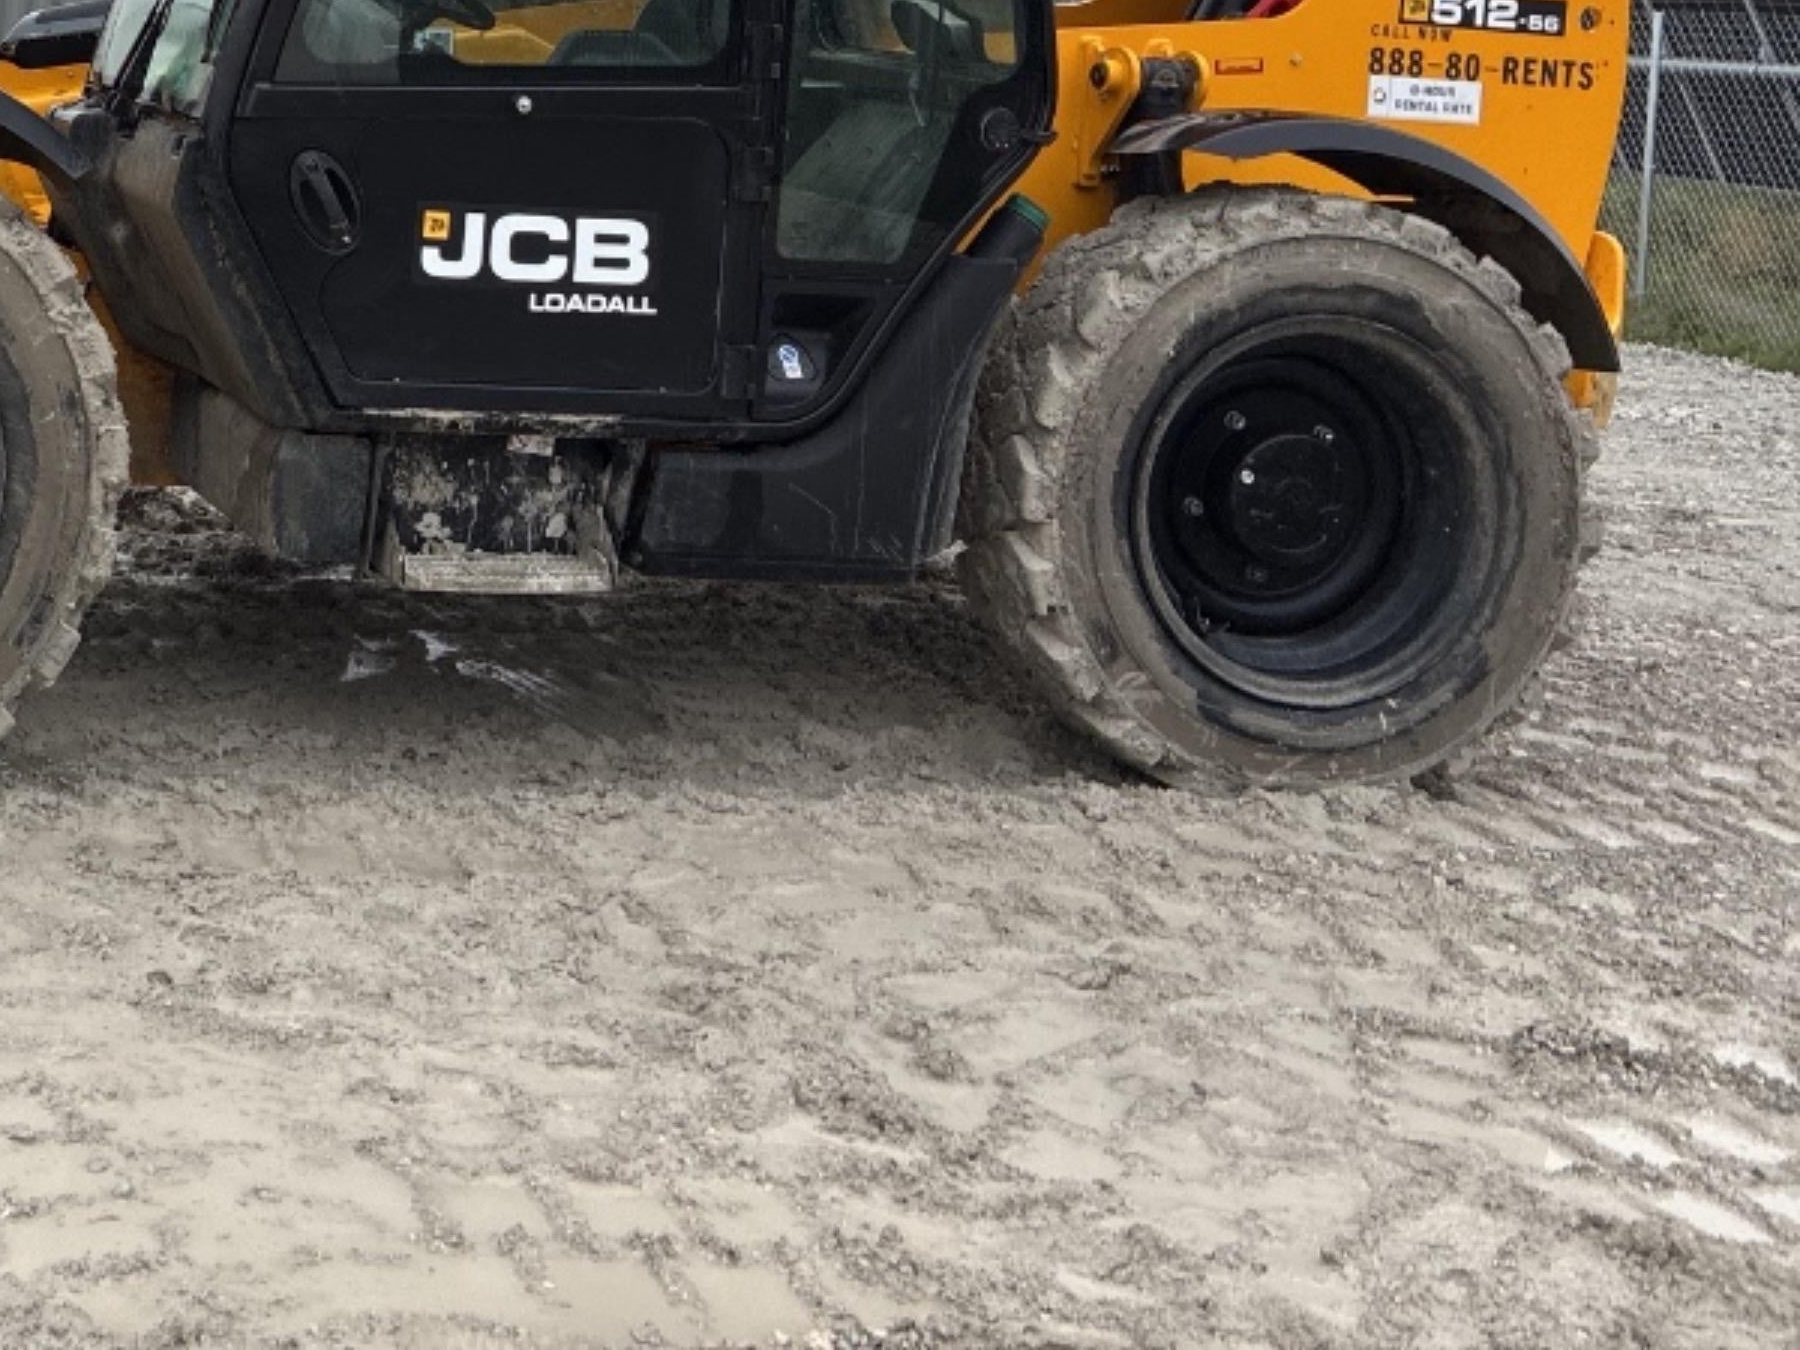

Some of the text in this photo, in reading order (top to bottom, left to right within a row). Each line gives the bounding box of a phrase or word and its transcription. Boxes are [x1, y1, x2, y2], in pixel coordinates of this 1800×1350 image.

[1368, 47, 1594, 91] 888-80-RENTS
[420, 211, 650, 285] JCB
[528, 292, 658, 315] LOADALL
